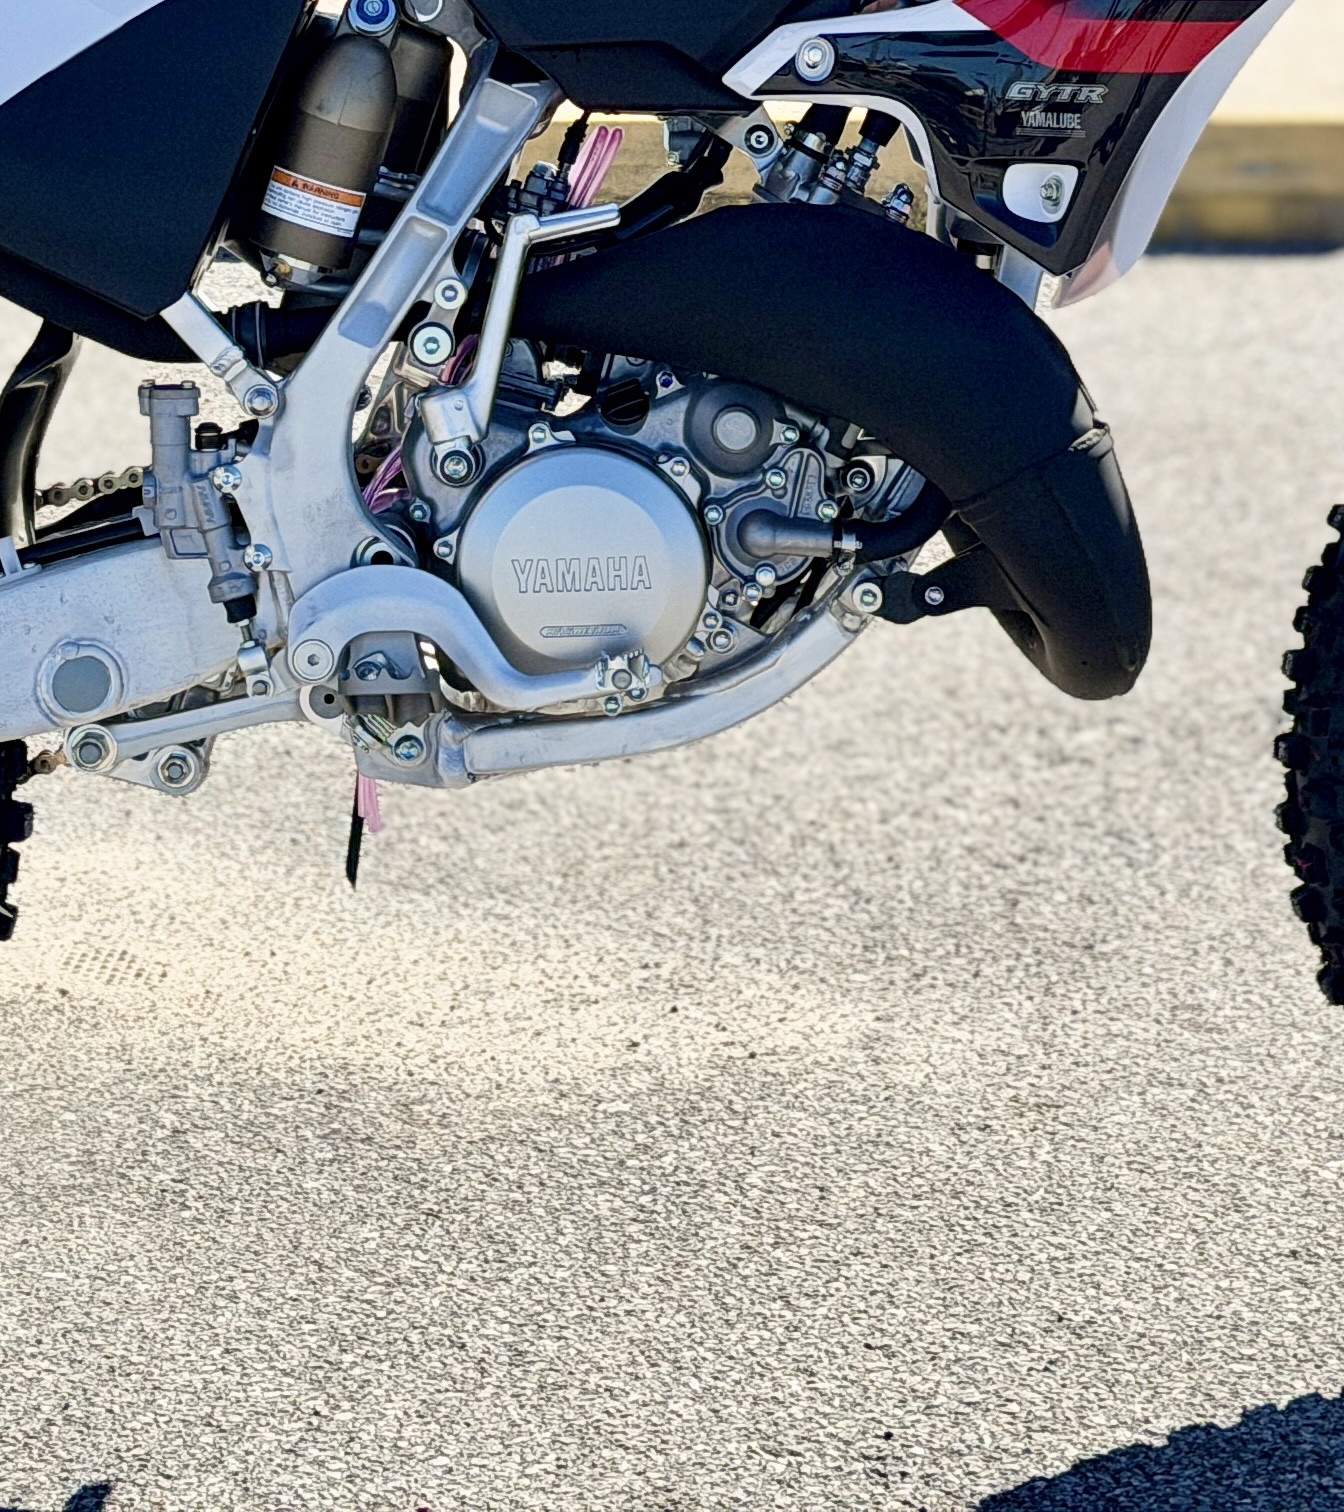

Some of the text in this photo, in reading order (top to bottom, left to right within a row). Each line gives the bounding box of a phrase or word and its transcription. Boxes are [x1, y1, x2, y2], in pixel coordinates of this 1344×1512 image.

[1005, 81, 1109, 104] GYTR
[1020, 110, 1083, 129] YAMALUBE
[510, 555, 653, 594] YAMAHA
